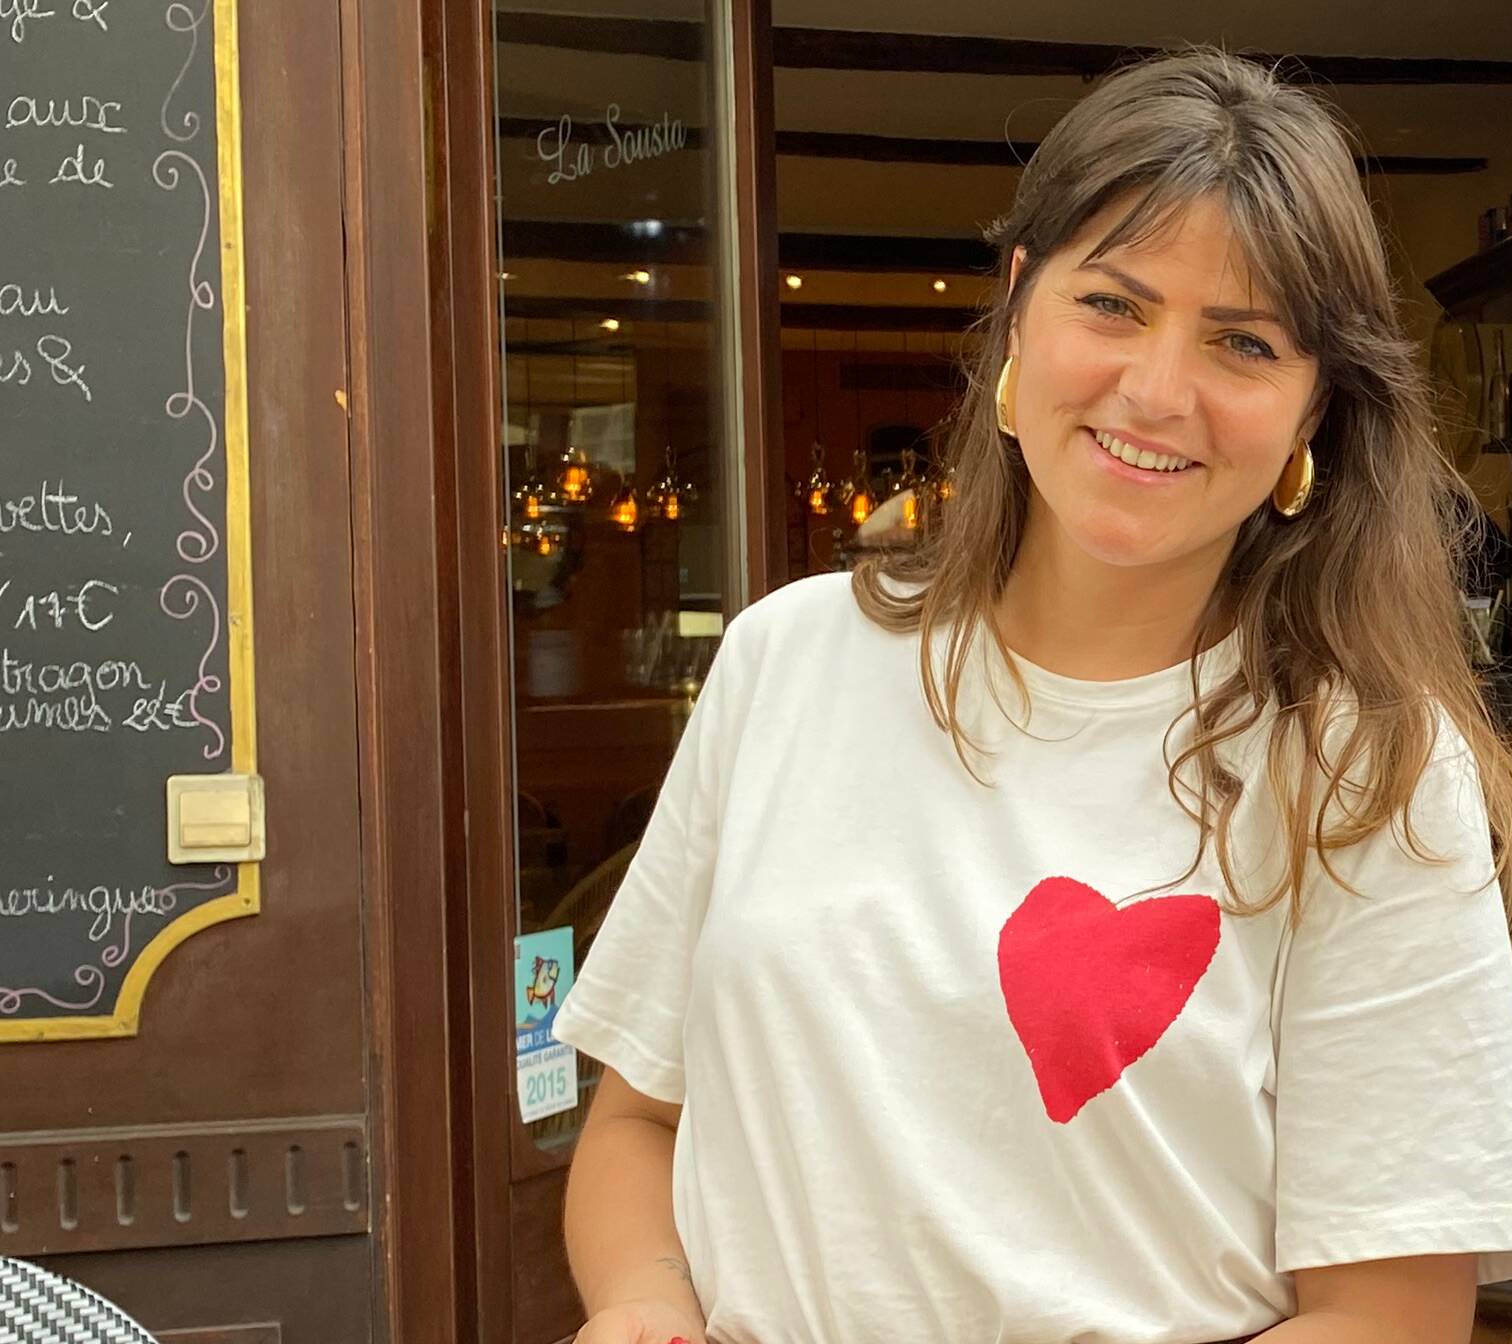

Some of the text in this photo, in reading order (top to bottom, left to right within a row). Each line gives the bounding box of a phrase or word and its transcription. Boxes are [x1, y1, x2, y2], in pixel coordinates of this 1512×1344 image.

[5, 96, 128, 133] aux
[48, 143, 114, 188] de
[537, 103, 688, 185] La Sousta
[0, 874, 164, 942] eringue
[526, 1067, 567, 1106] 2015
